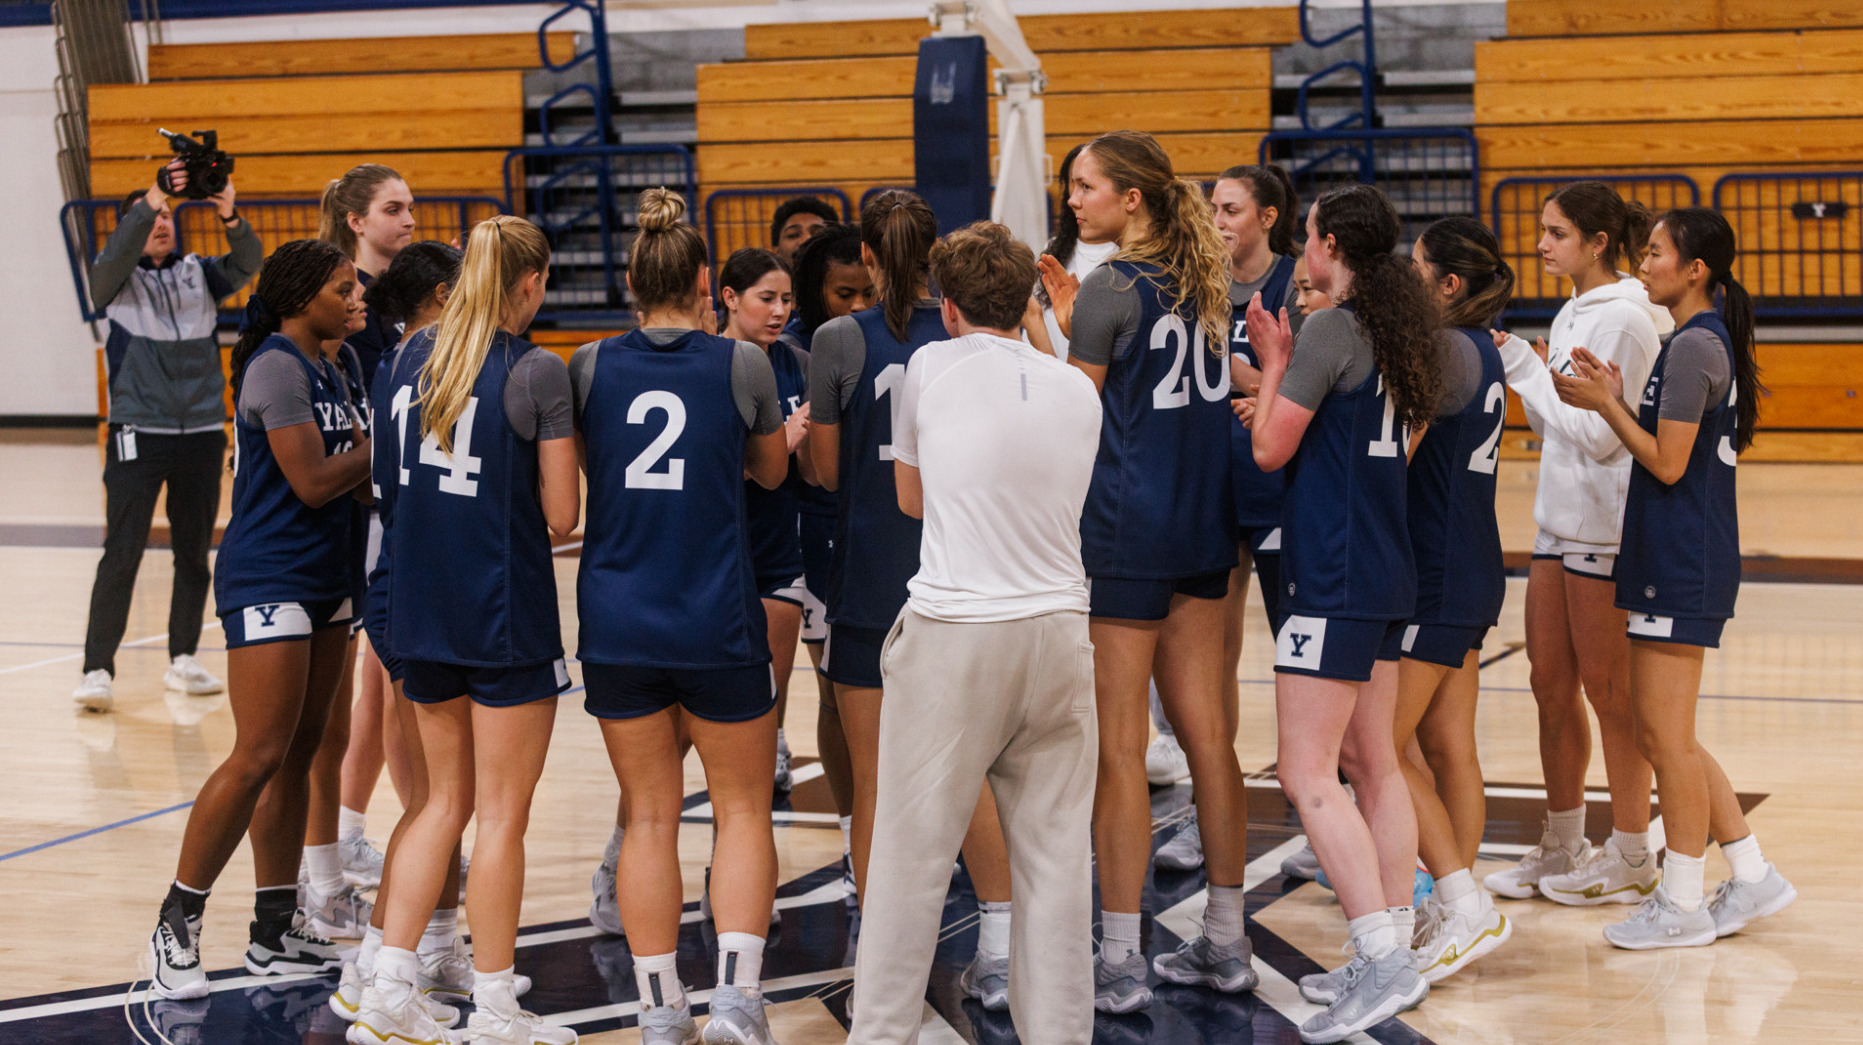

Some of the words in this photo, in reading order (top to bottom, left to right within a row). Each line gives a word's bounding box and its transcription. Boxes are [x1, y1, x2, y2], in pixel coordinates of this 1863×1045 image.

[1149, 313, 1231, 409] 20
[391, 385, 482, 498] 14
[625, 390, 687, 491] 2
[254, 604, 280, 627] Y
[1289, 632, 1312, 658] Y
